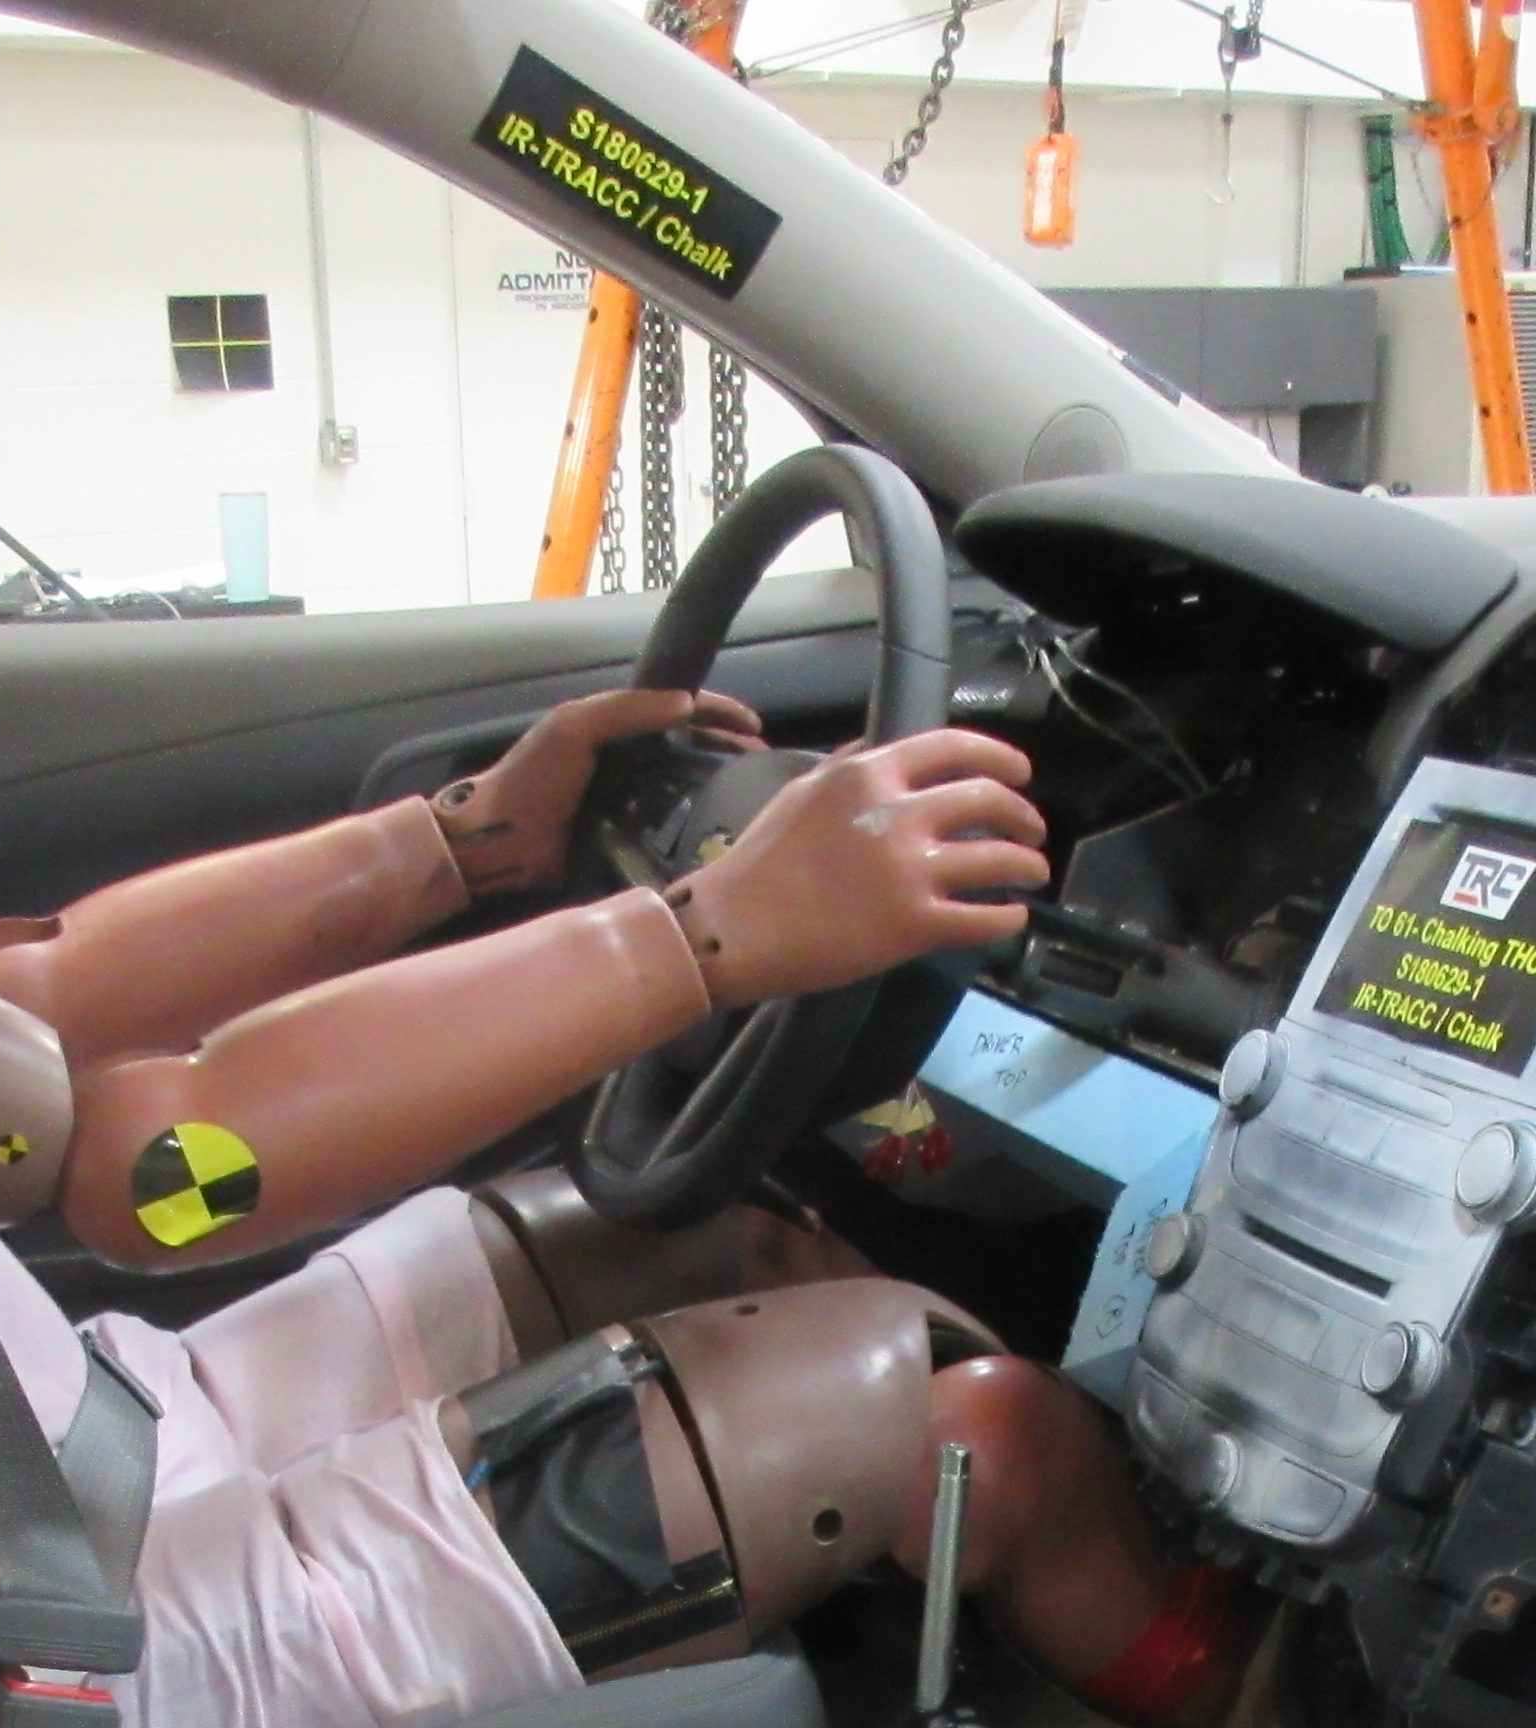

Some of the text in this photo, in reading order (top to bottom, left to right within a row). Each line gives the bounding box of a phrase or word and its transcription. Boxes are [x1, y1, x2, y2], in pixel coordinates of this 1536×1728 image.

[570, 108, 709, 214] S180629-1
[497, 113, 734, 281] IR-TRACC / Chalk
[498, 273, 591, 290] ADMITT
[1459, 853, 1528, 908] TRC
[1369, 904, 1394, 932] TO
[1392, 911, 1419, 938] 61-
[1421, 918, 1499, 968] Chalking
[1396, 952, 1486, 1001] S180629-1
[1353, 982, 1505, 1053] IR-TRACC / Chalk
[995, 1069, 1028, 1091] TOP
